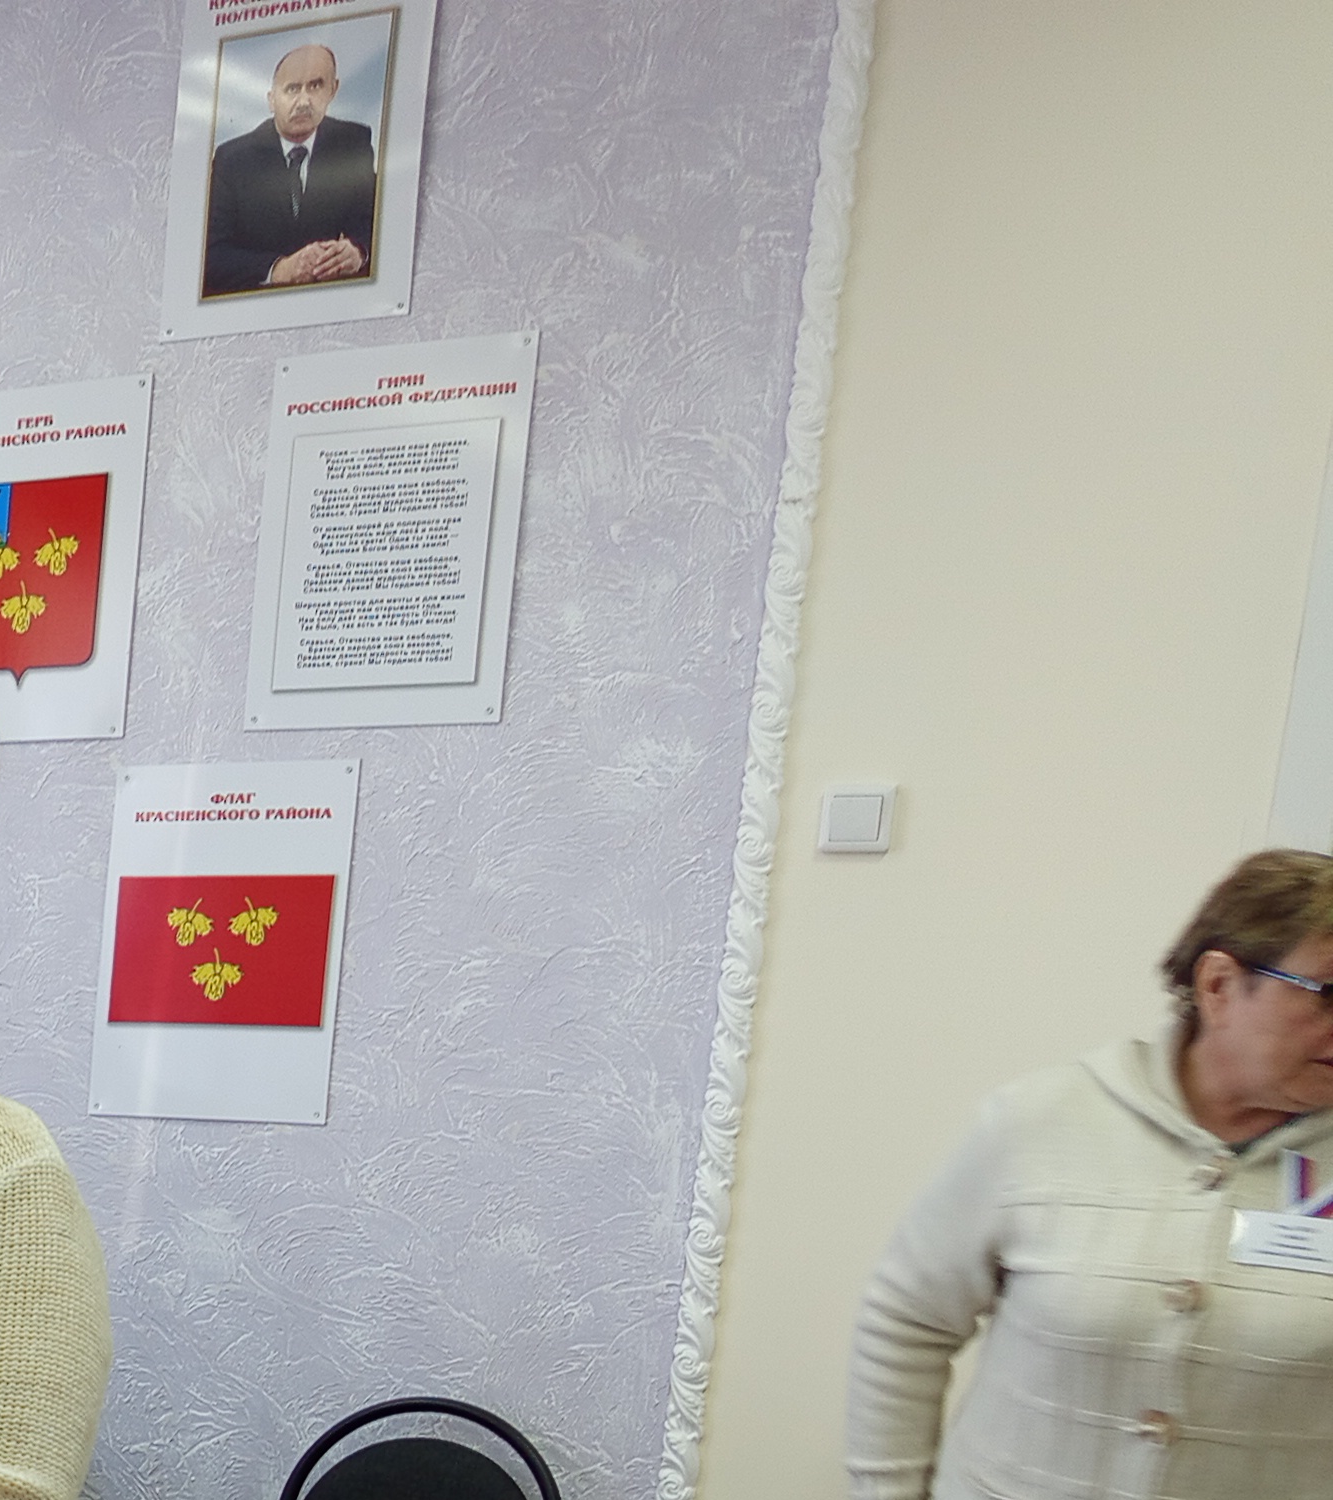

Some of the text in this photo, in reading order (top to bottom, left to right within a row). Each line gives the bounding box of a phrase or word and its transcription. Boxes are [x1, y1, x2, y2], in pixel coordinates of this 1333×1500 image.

[215, 0, 354, 26] ПОЛТОРАБАТЬ
[377, 374, 425, 390] ГИМН
[286, 381, 517, 416] РОССИЙСКОЙ ФЕДЕРАЦИИ
[17, 414, 54, 430] ГЕРБ
[65, 423, 127, 441] РАЙОНА
[210, 792, 256, 805] ФЛАГ
[134, 806, 333, 824] КРАСНЕНСКОГО РАЙОНА
